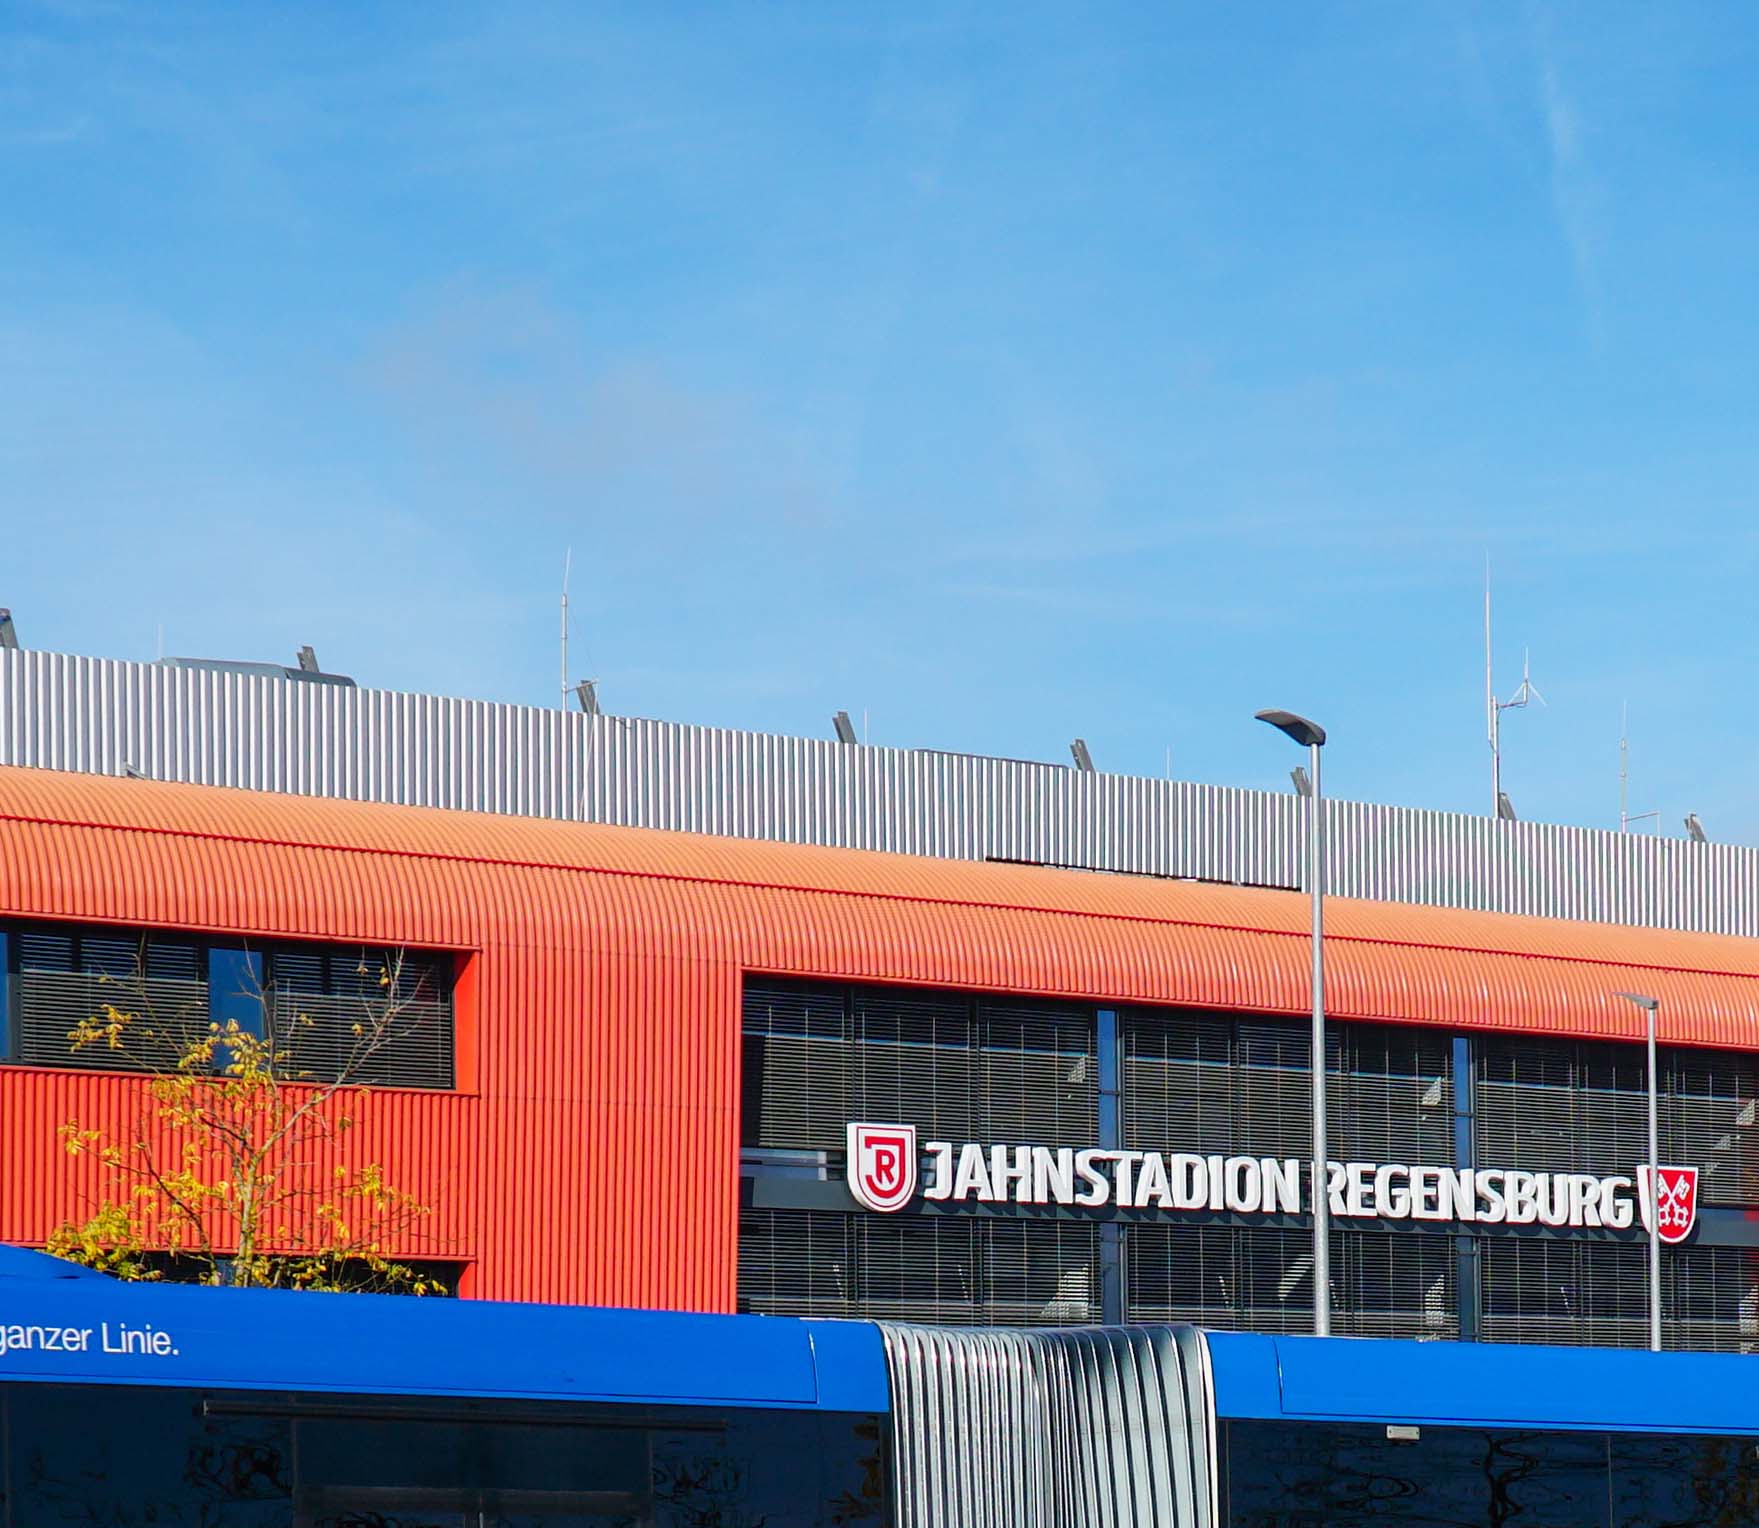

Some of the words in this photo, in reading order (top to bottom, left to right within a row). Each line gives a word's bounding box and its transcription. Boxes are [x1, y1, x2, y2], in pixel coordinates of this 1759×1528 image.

[924, 1141, 1300, 1216] JAHNSTADION
[1311, 1160, 1634, 1229] REGENSBURG
[102, 1321, 179, 1355] Linie.
